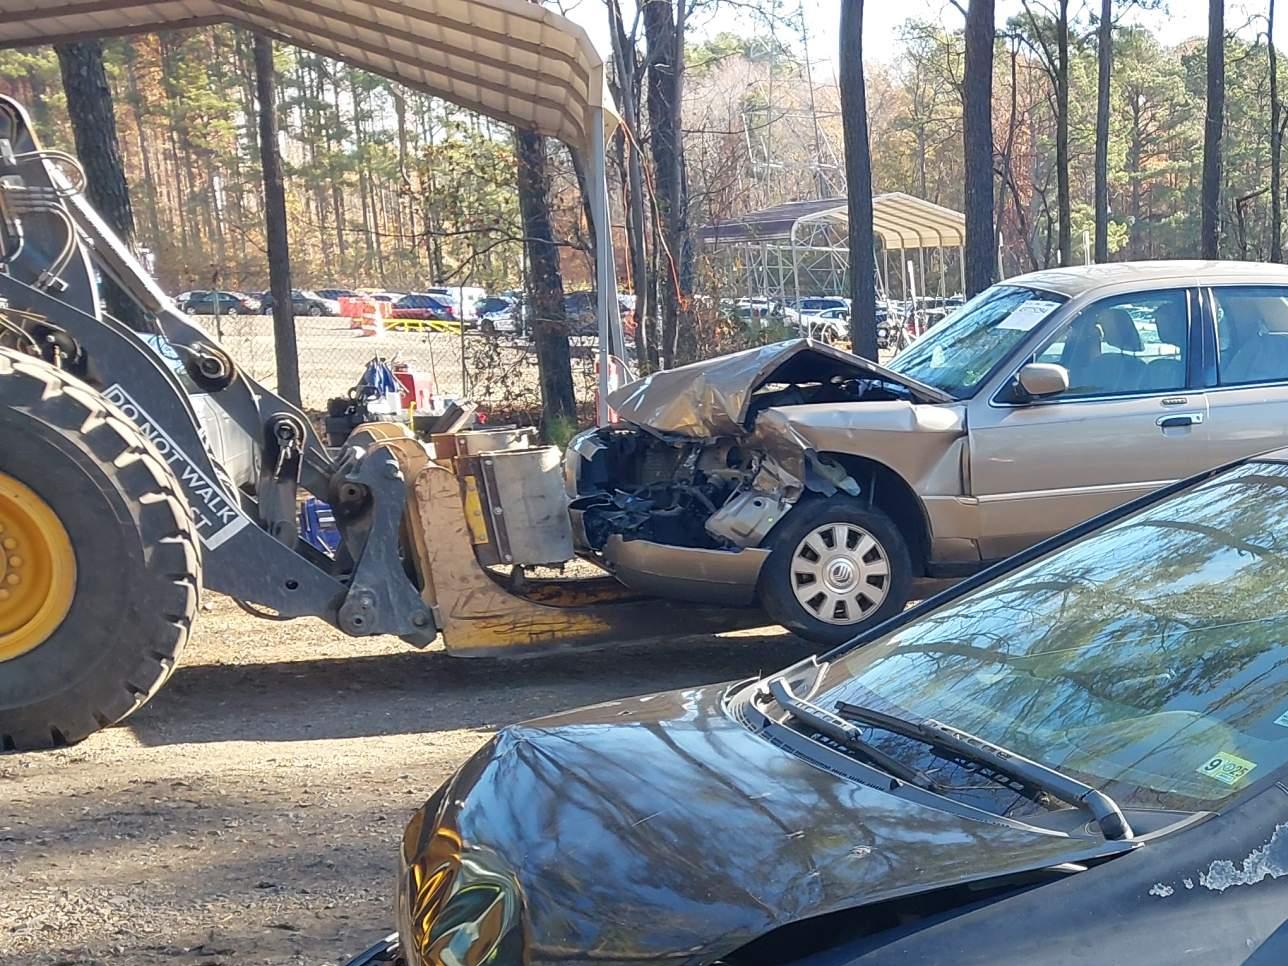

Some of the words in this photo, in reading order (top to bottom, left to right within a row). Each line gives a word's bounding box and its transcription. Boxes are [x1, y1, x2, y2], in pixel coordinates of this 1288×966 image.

[105, 389, 139, 420] DO
[139, 421, 184, 465] NOT
[181, 465, 236, 524] WALK
[1204, 758, 1223, 771] 9
